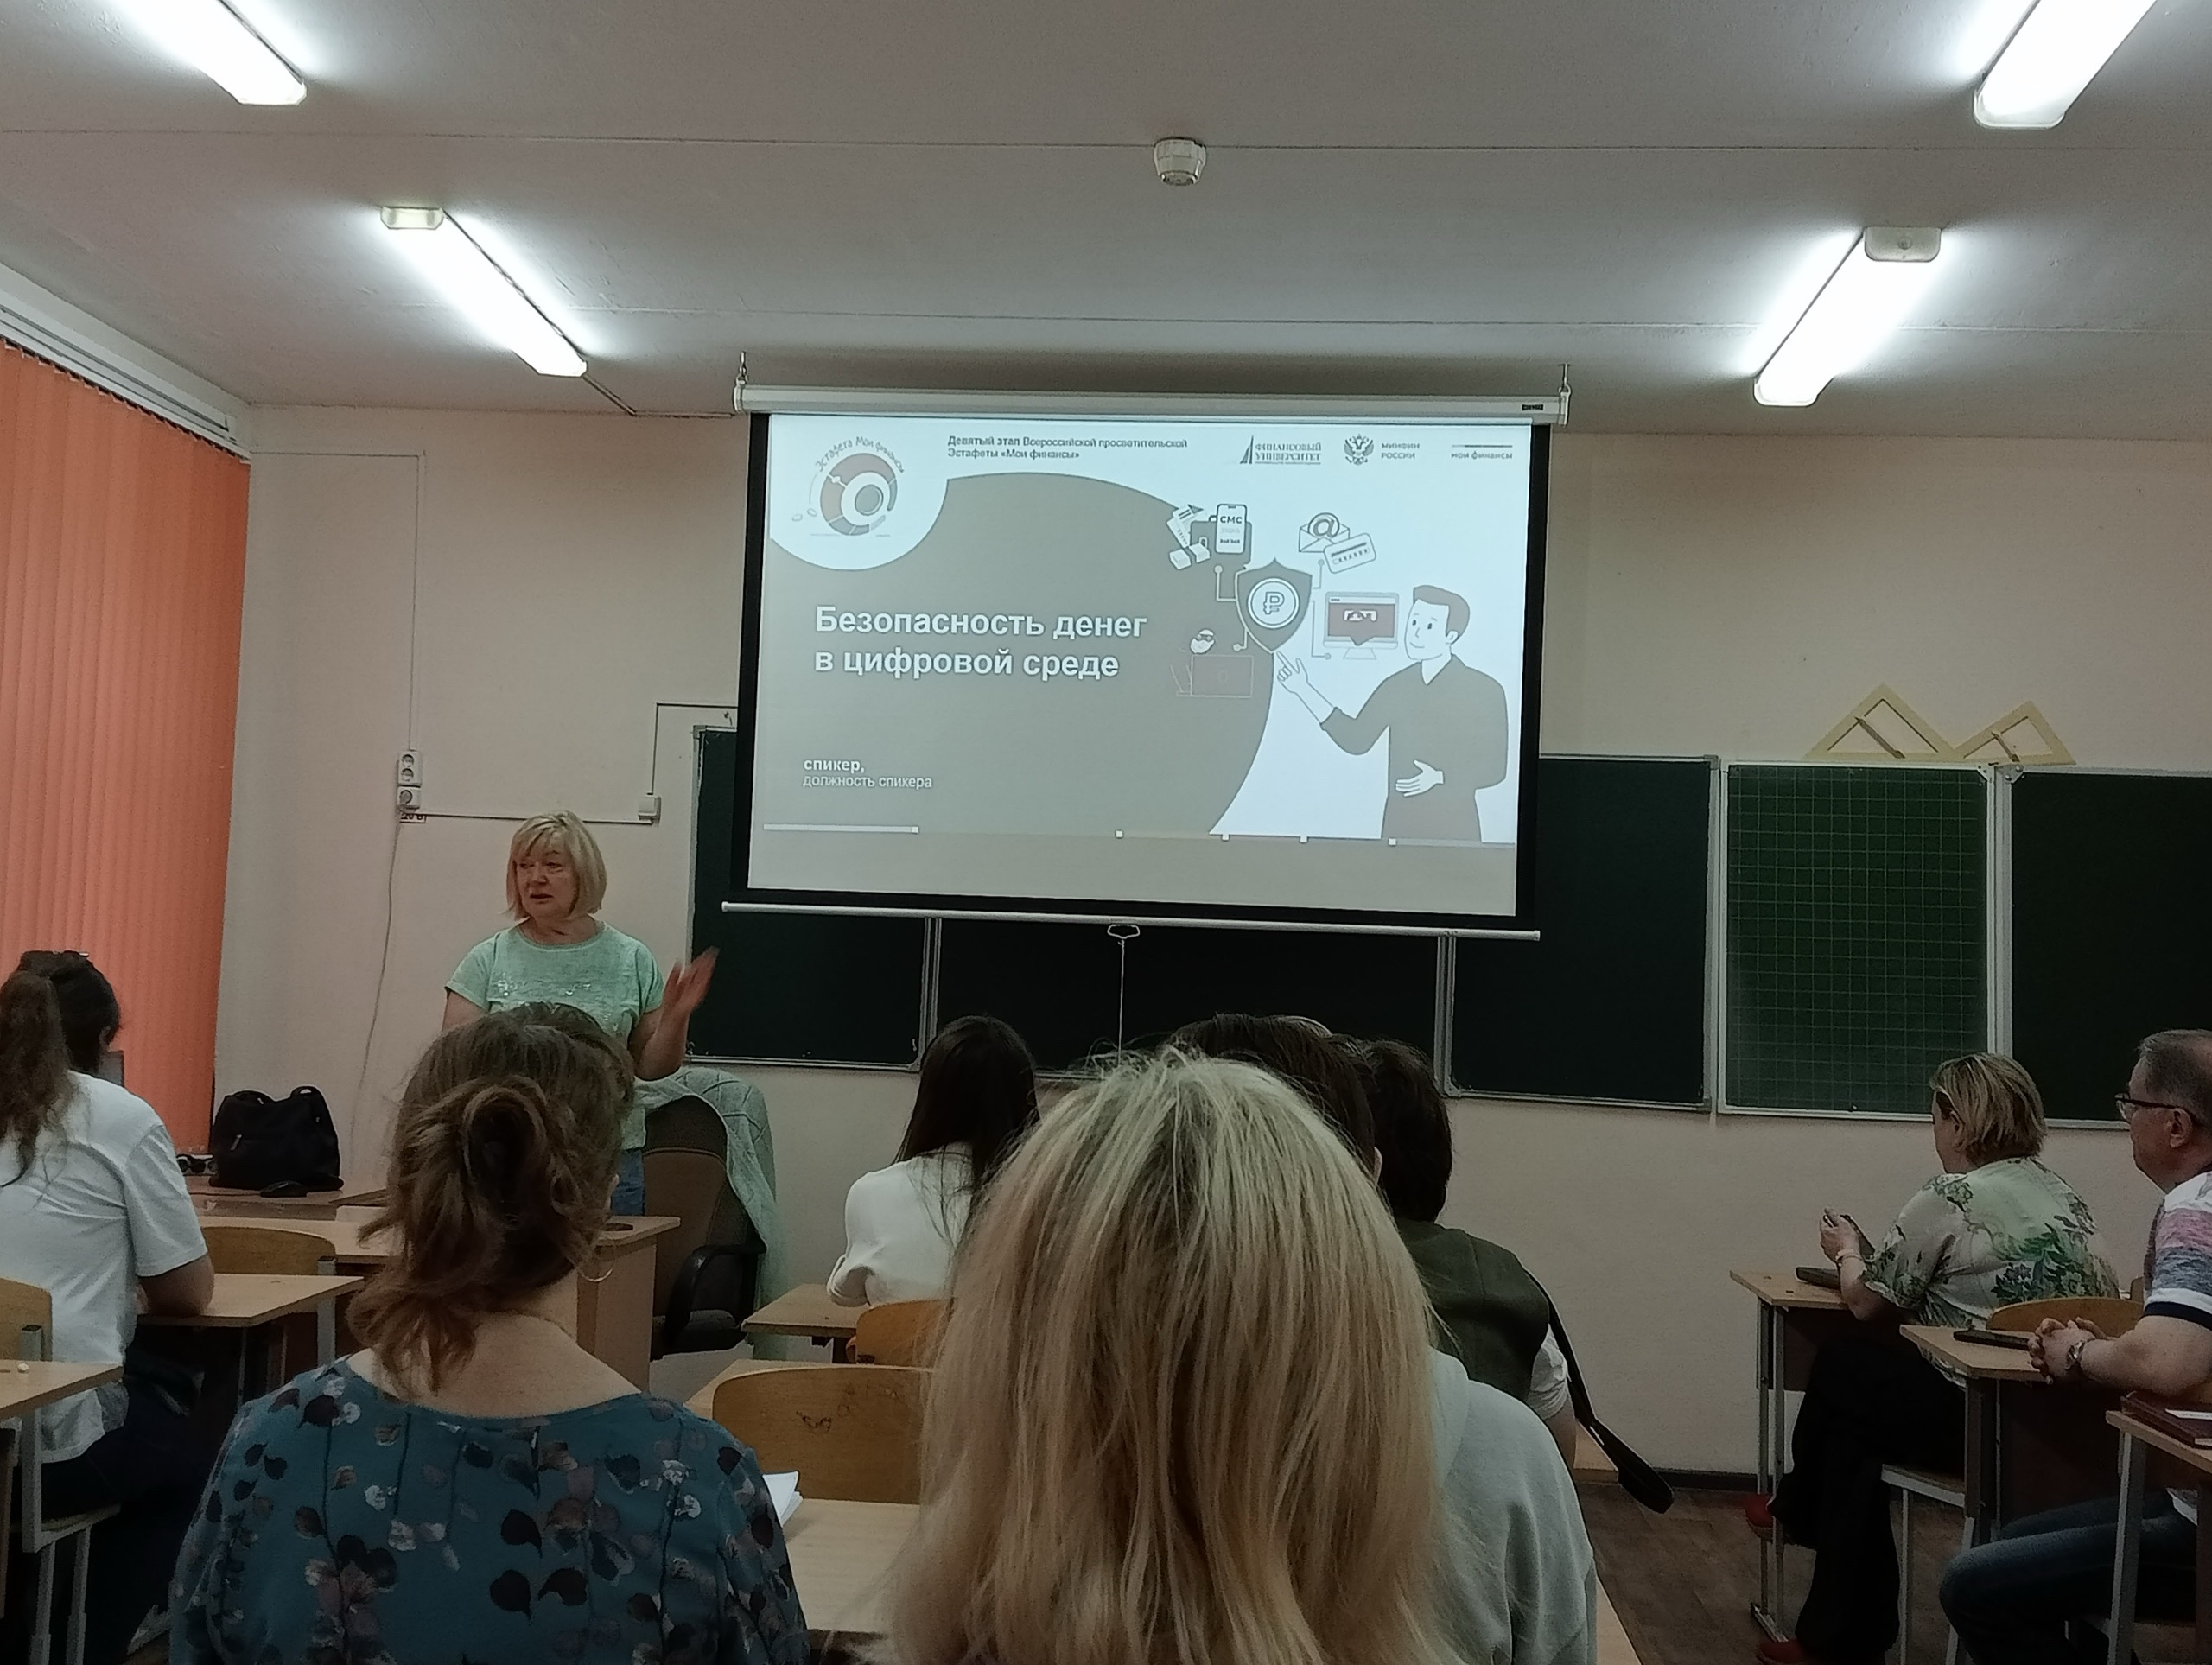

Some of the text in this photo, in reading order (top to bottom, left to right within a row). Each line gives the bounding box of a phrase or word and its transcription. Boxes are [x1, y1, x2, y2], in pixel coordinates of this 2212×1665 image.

[855, 436, 874, 448] Мои
[947, 435, 1188, 449] Девятый этап Всероссийской просветительской
[1255, 442, 1322, 451] ФИНАНСОВЫЙ
[947, 448, 1080, 461] Эстафеты «Мои финансы»
[1255, 452, 1322, 461] УНИВЕРСИТЕТ
[1219, 515, 1243, 524] СМС
[815, 606, 1147, 639] Безопасность денег
[815, 647, 1120, 682] в цифровой среде
[804, 759, 865, 774] спикер,
[802, 775, 933, 790] должность спикера
